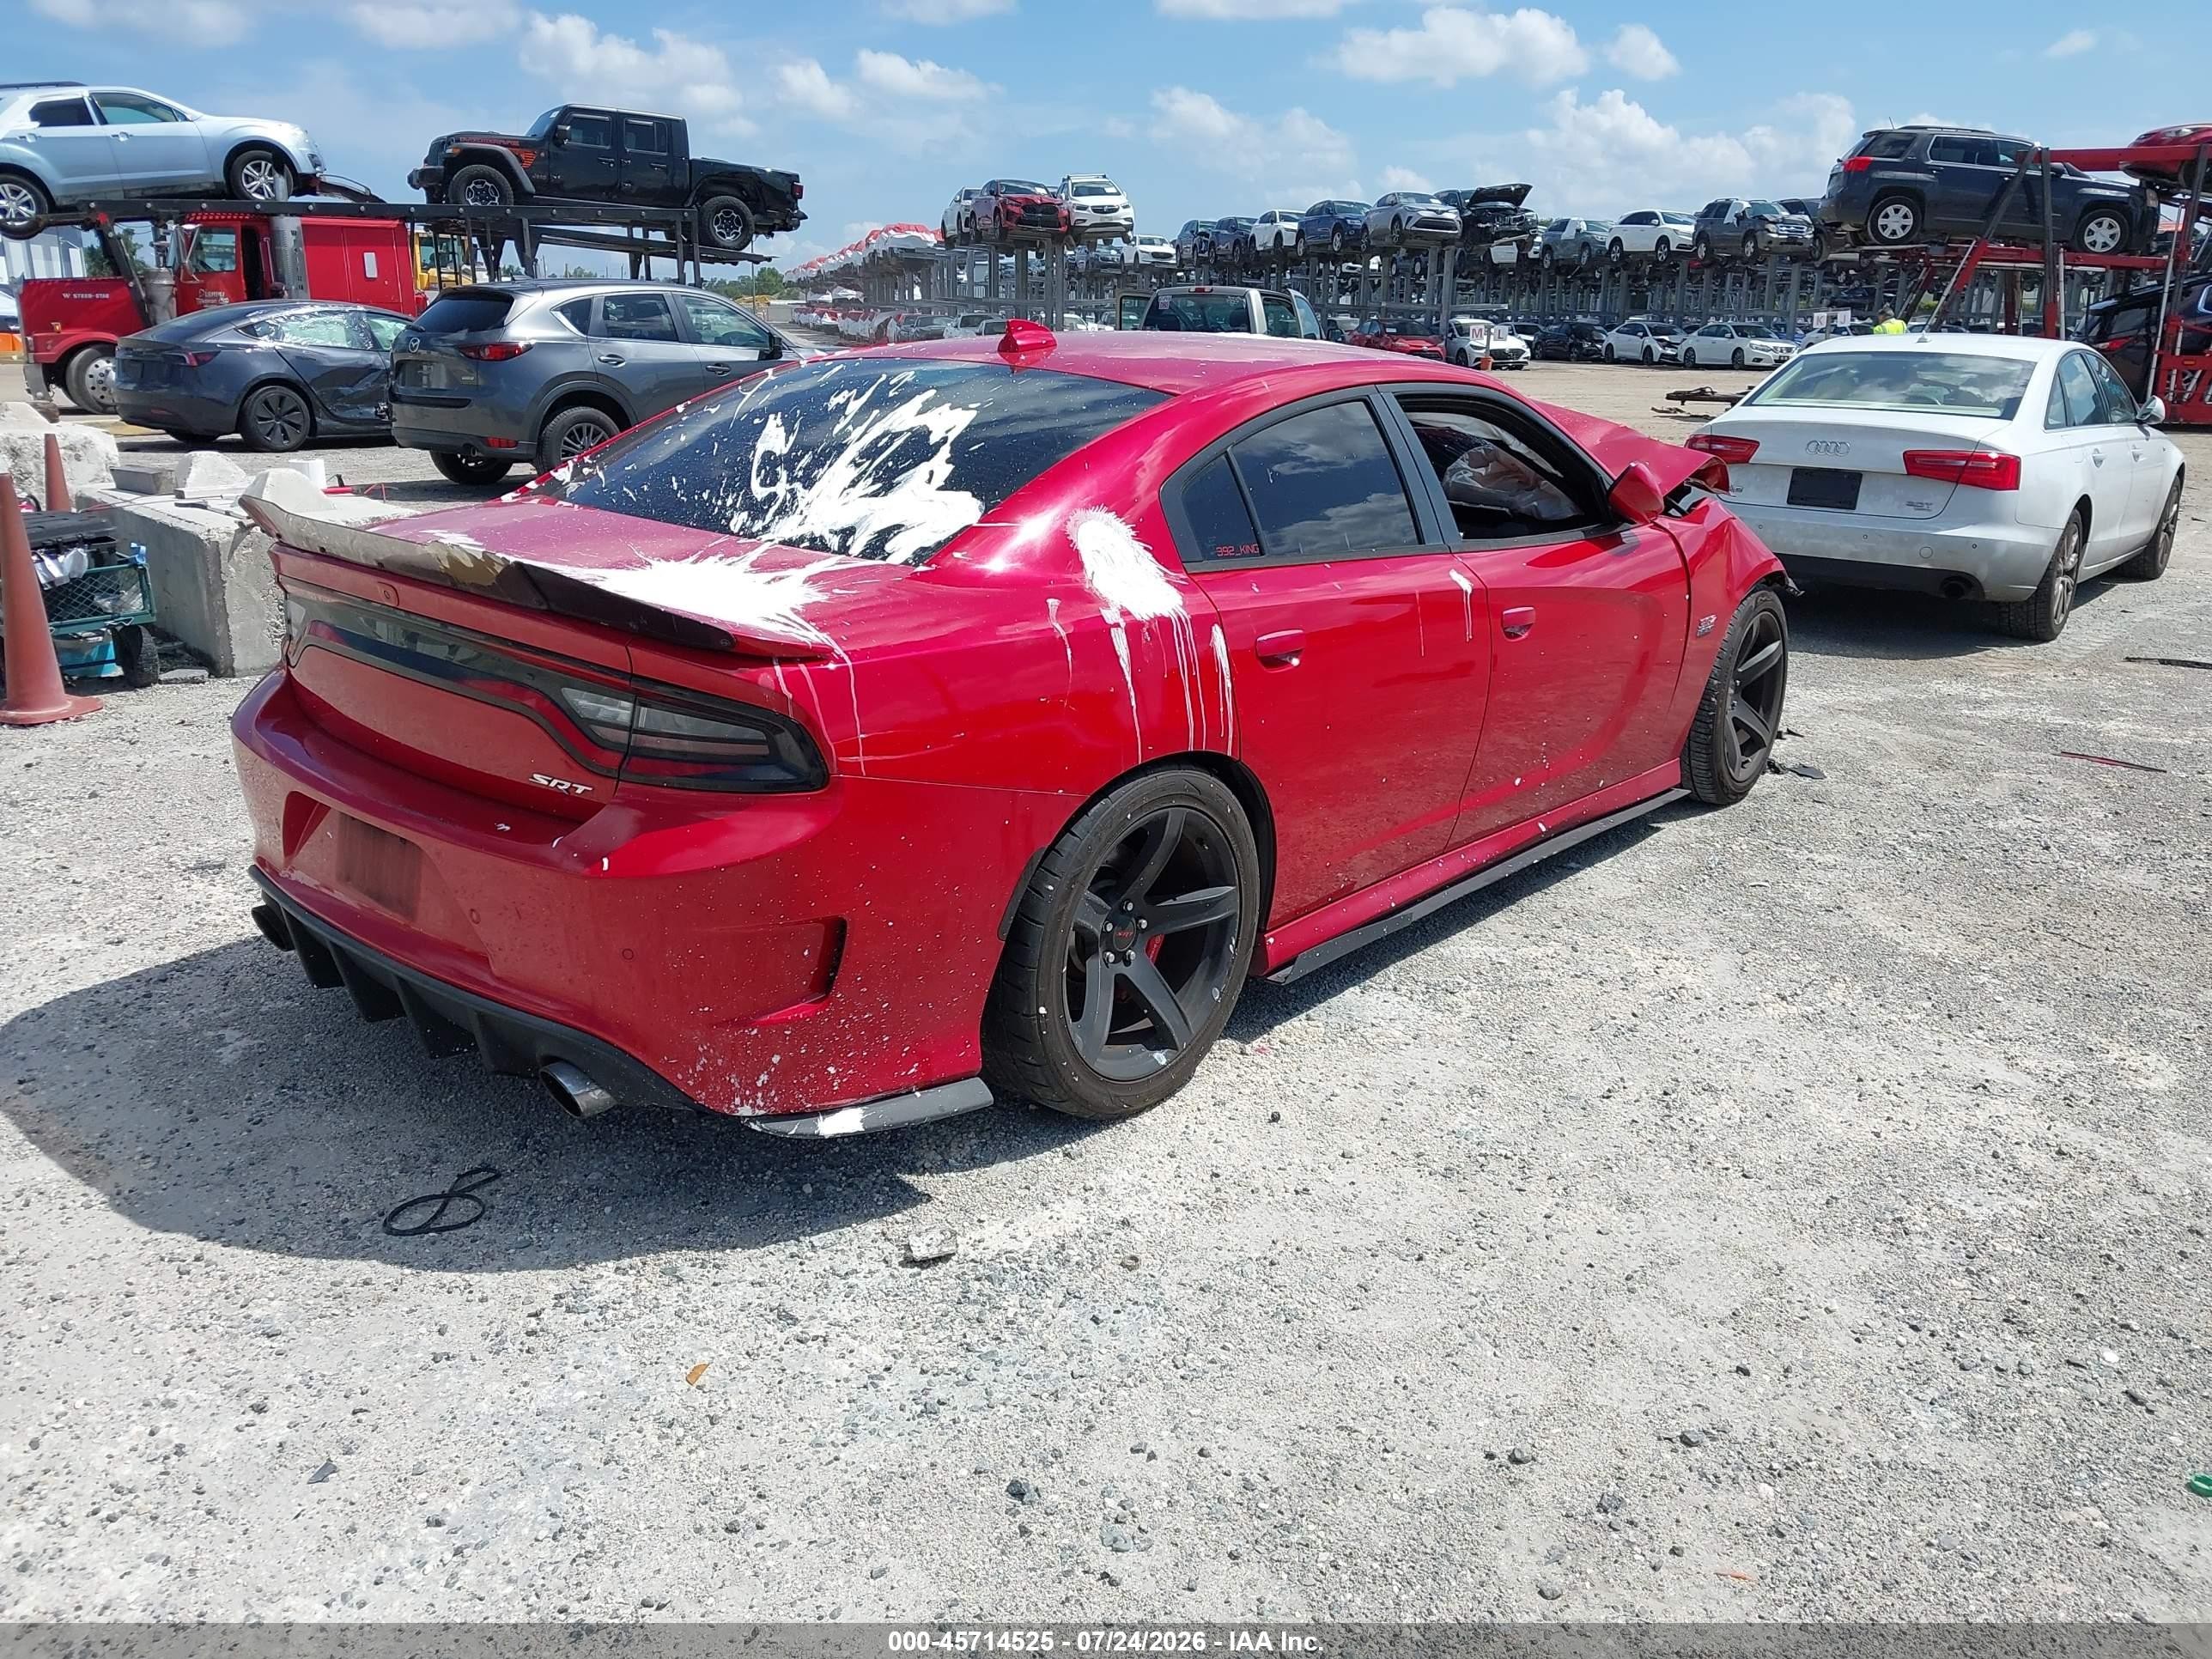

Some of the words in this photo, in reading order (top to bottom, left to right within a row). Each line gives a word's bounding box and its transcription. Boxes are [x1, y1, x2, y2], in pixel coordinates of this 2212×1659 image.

[1816, 315, 1825, 326] K
[1471, 328, 1484, 339] M
[1497, 329, 1504, 340] L
[1215, 544, 1260, 556] 392_KING
[528, 773, 593, 795] SRT
